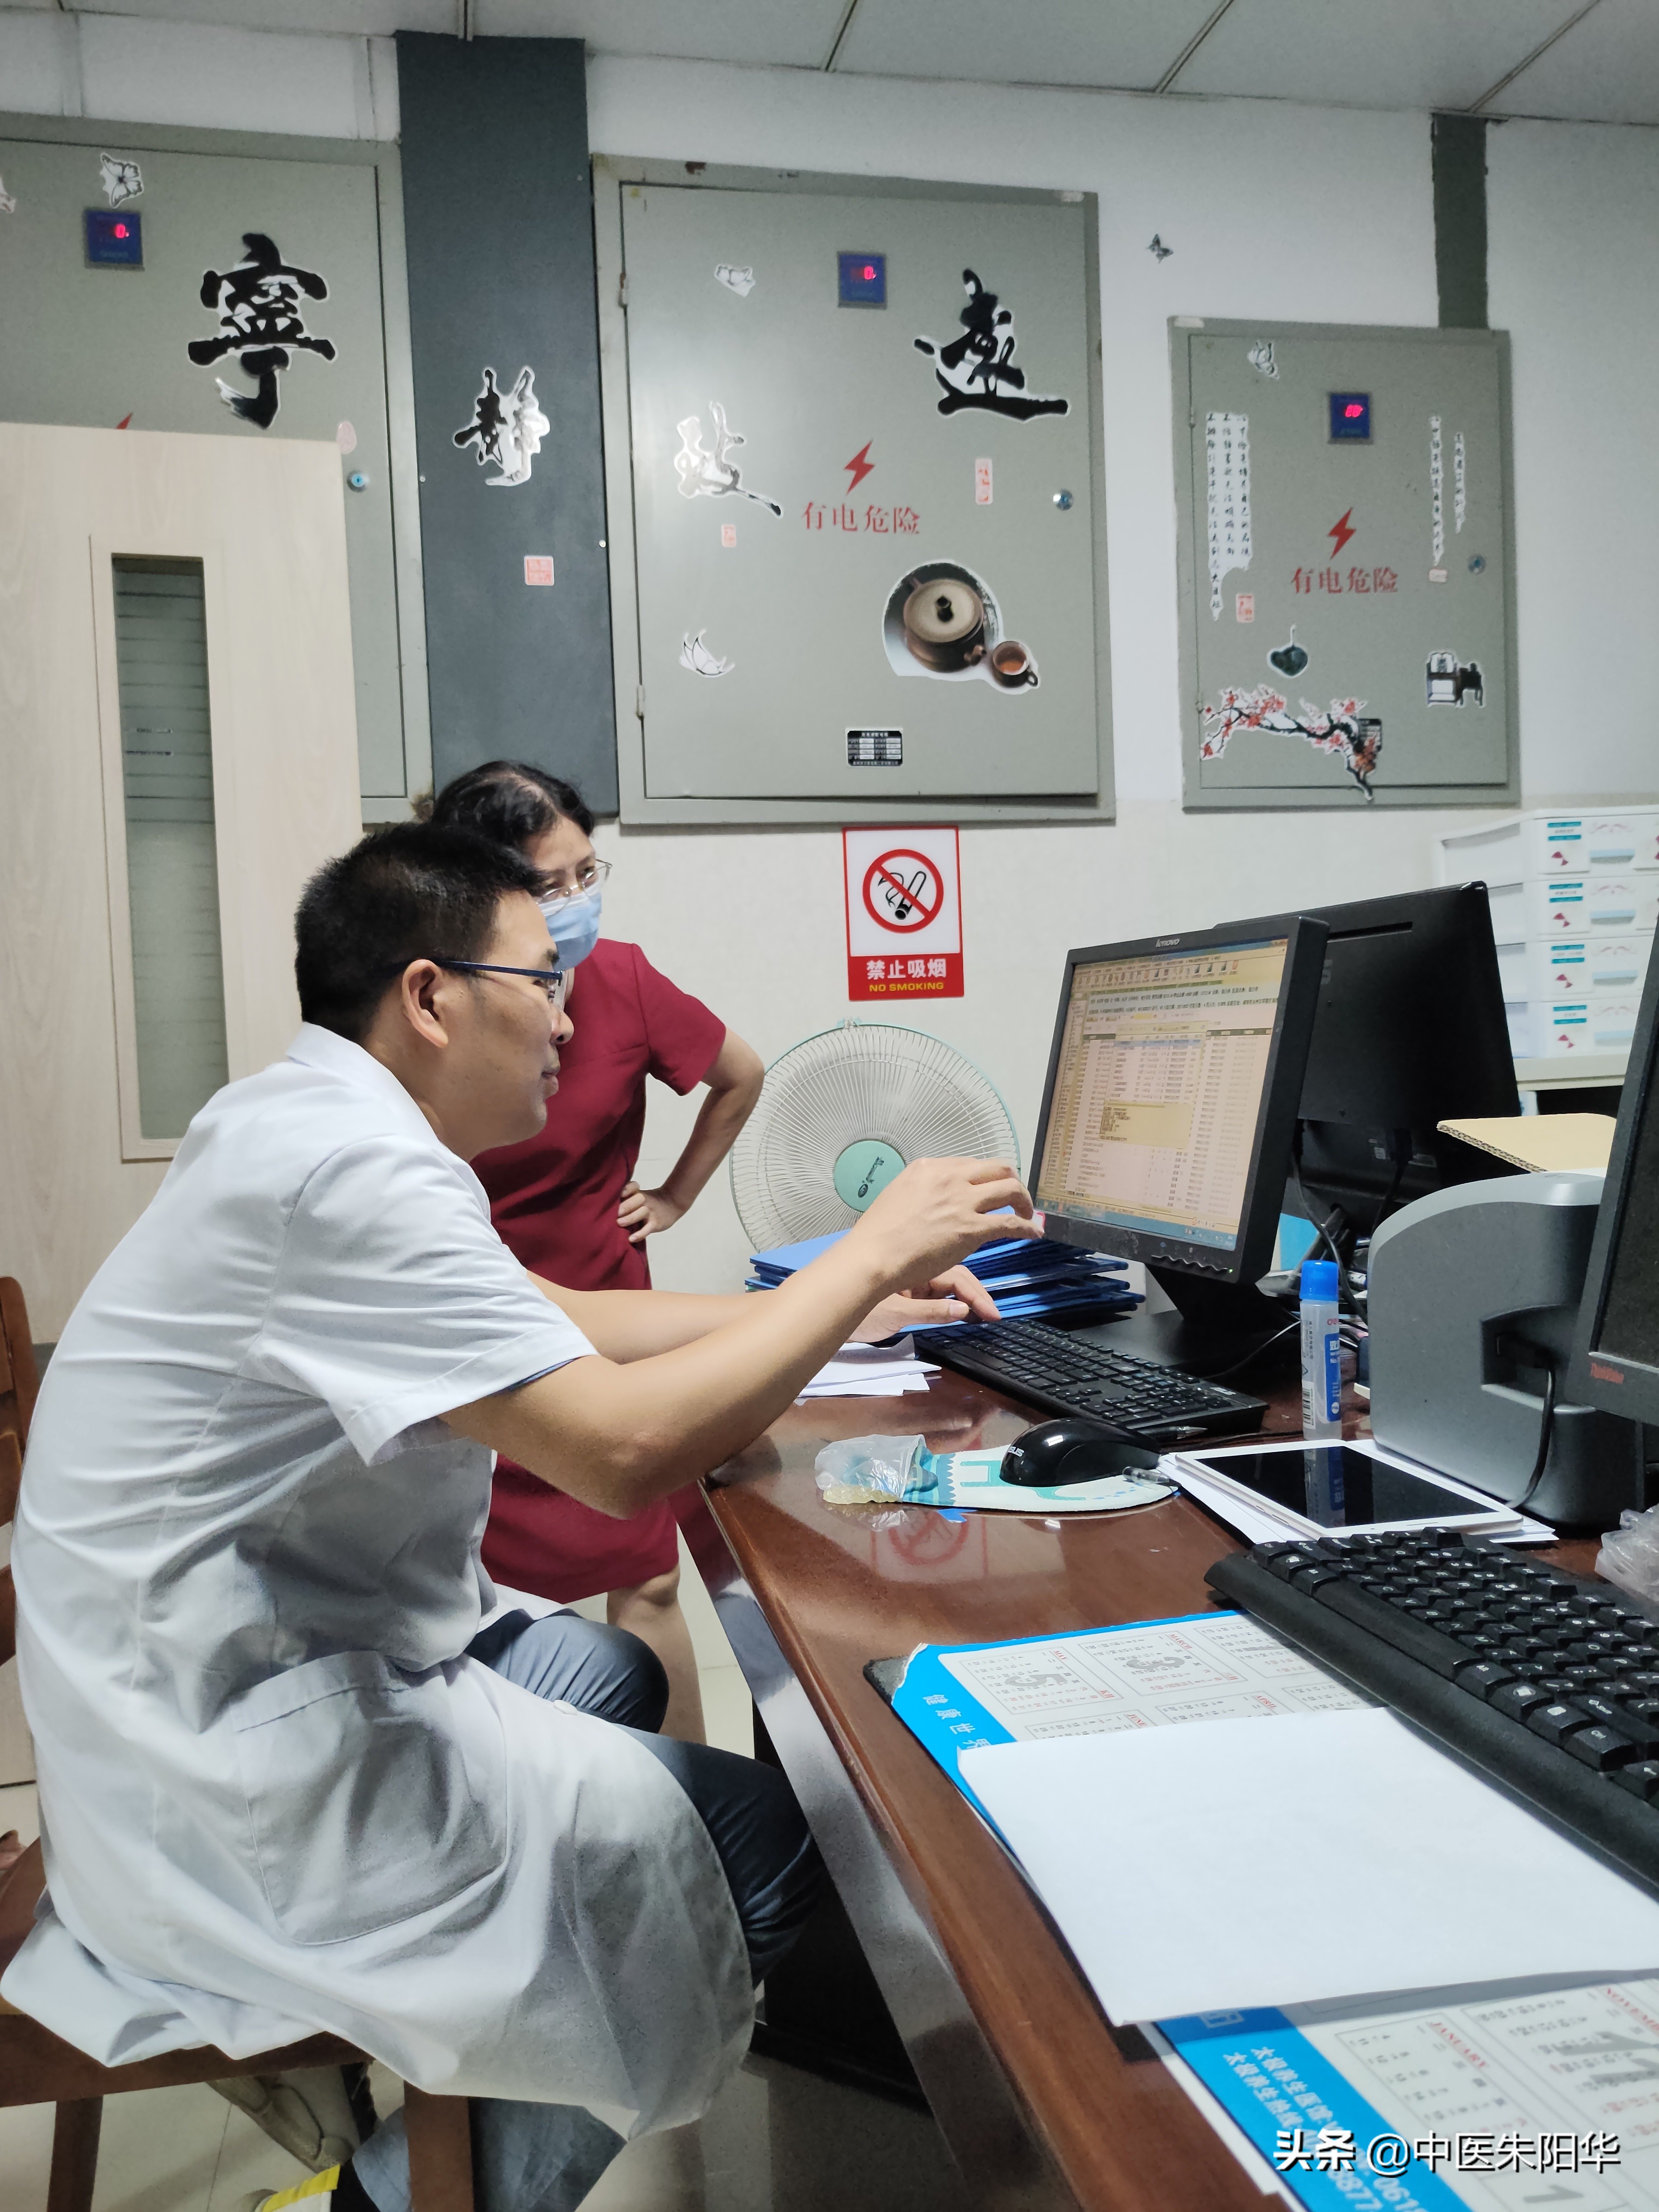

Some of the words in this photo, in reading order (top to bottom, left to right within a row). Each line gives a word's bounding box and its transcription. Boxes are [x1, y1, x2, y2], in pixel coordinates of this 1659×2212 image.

[801, 502, 920, 534] 有电危险
[1291, 566, 1398, 594] 有电危险
[1155, 939, 1179, 948] lenovo
[866, 959, 947, 980] 禁止吸烟
[889, 982, 944, 991] SMOKING
[1168, 1634, 1192, 1648] MARCH
[1053, 1650, 1068, 1659] MAY
[1126, 1656, 1185, 1670] 3
[1005, 1673, 1068, 1686] 5
[1254, 1696, 1279, 1709] APRIL
[1126, 1714, 1148, 1726] JUNE
[1427, 2021, 1486, 2067] JANUARY
